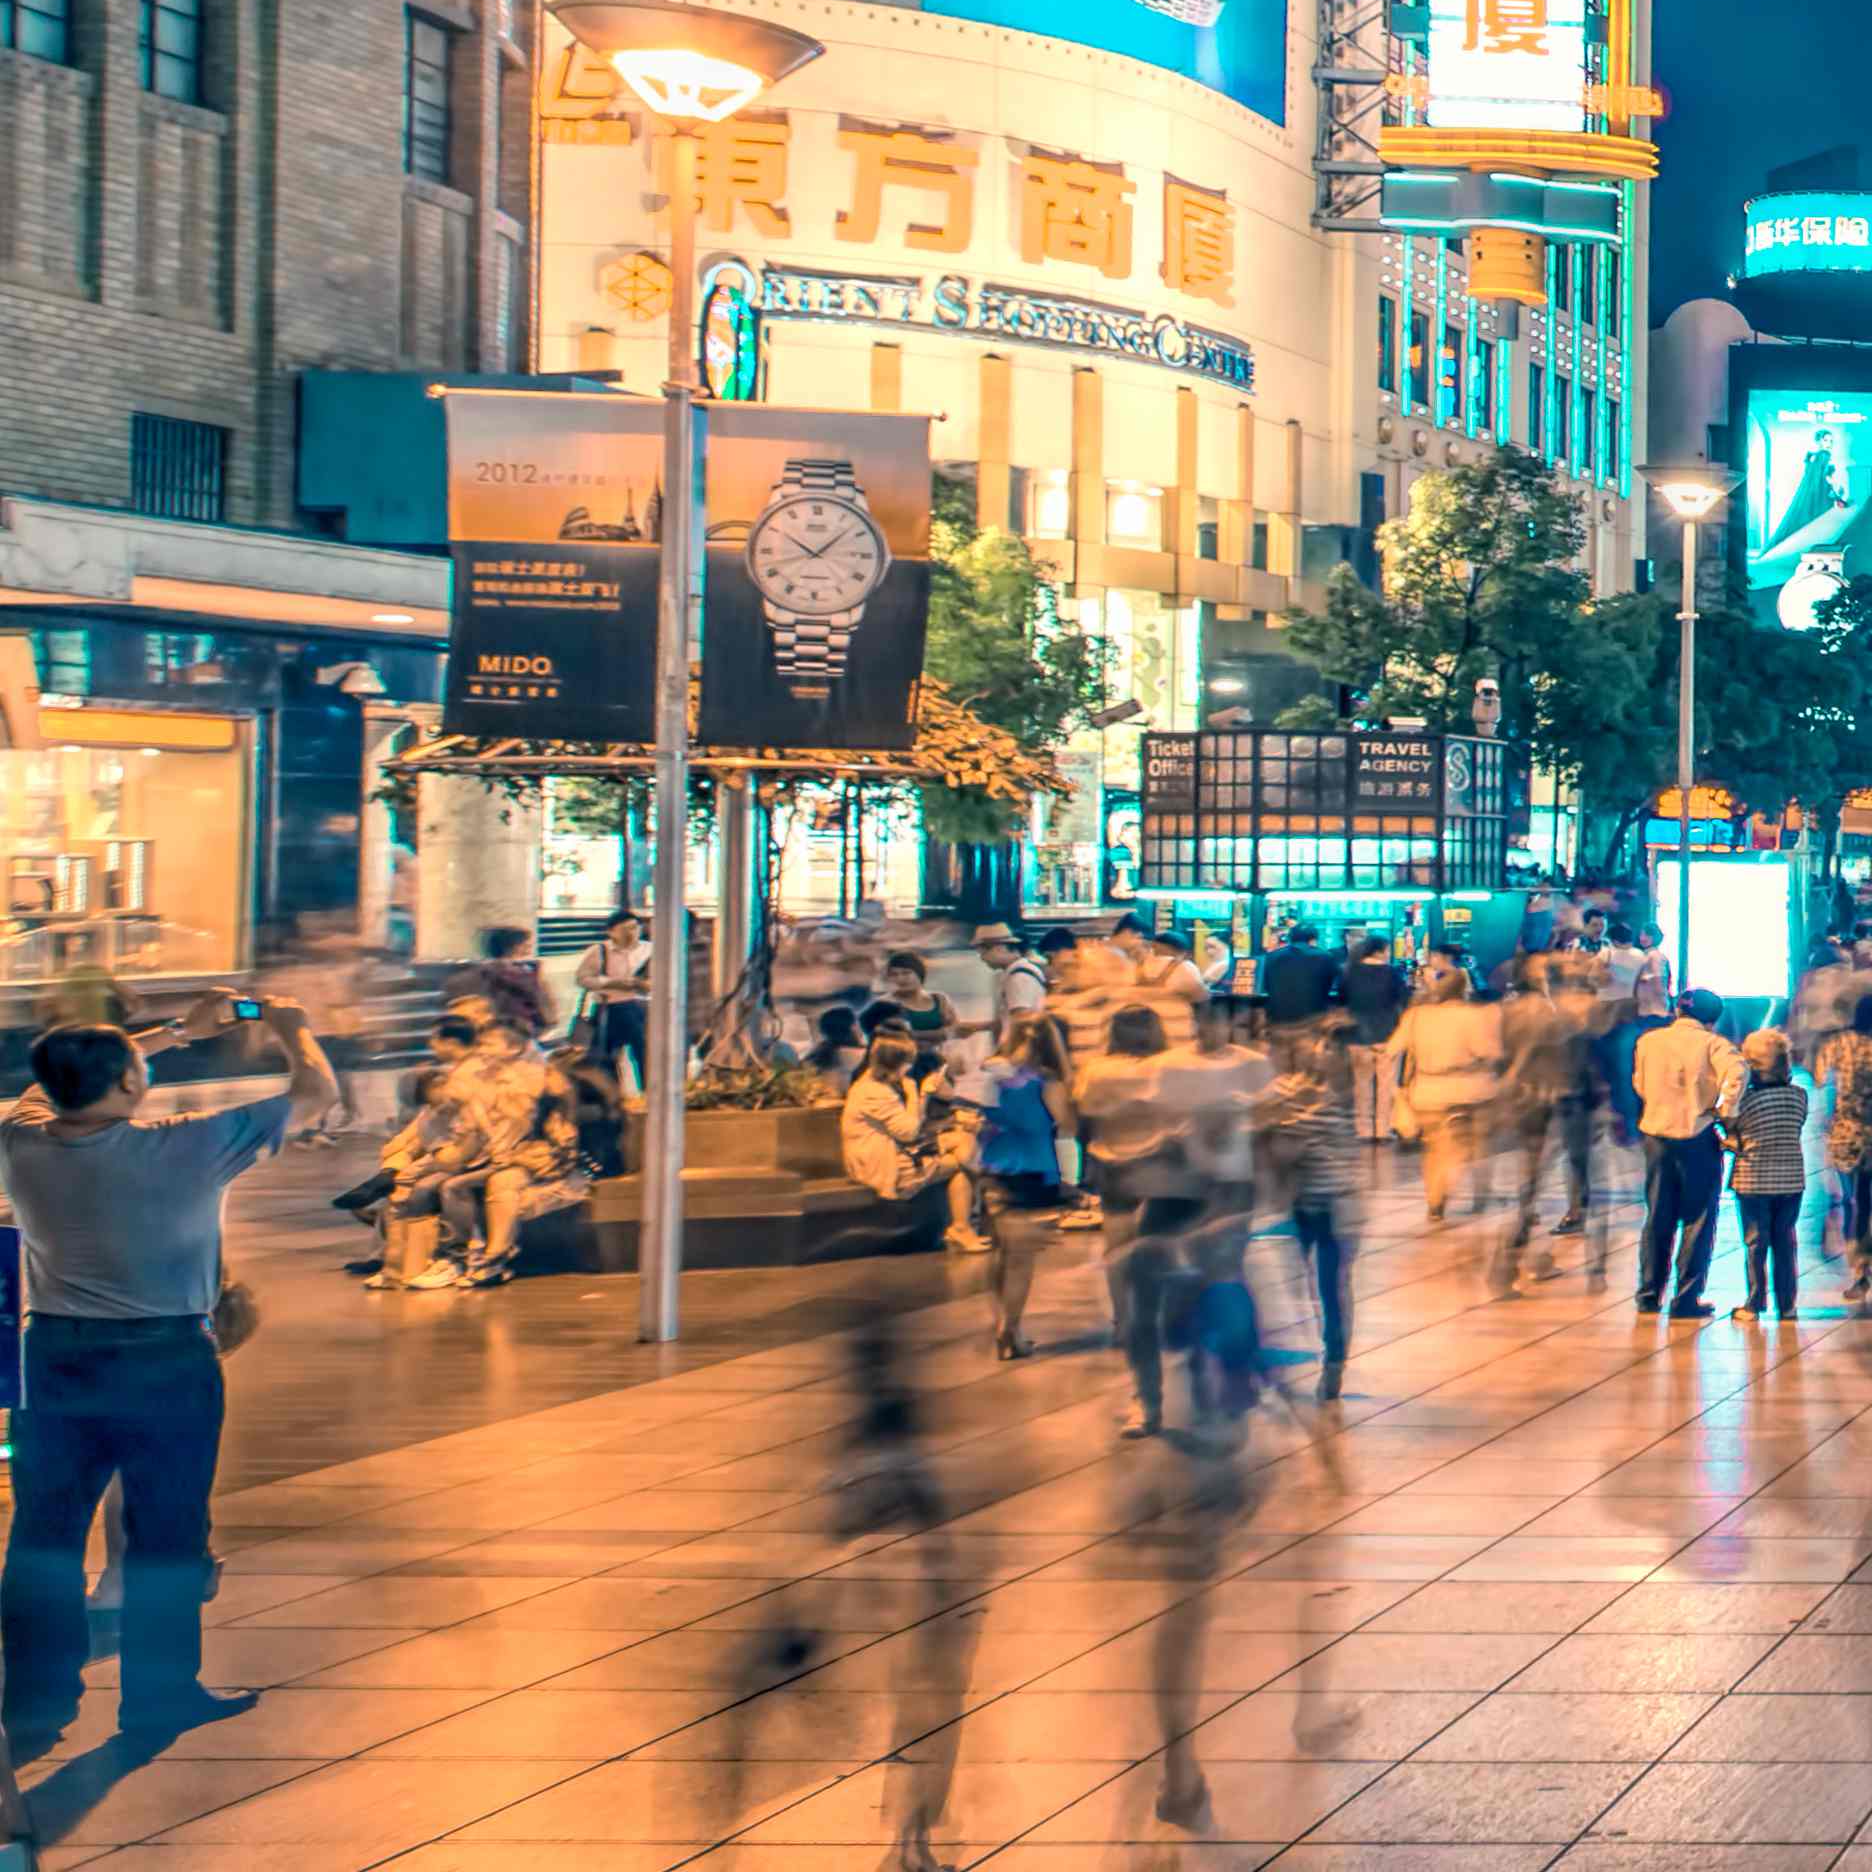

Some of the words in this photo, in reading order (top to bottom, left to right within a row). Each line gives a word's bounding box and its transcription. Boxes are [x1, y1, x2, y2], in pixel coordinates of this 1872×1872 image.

[475, 461, 538, 485] 2012
[477, 654, 554, 675] MIDO
[1359, 741, 1432, 756] TRAVEL
[1359, 759, 1432, 773] AGENCY
